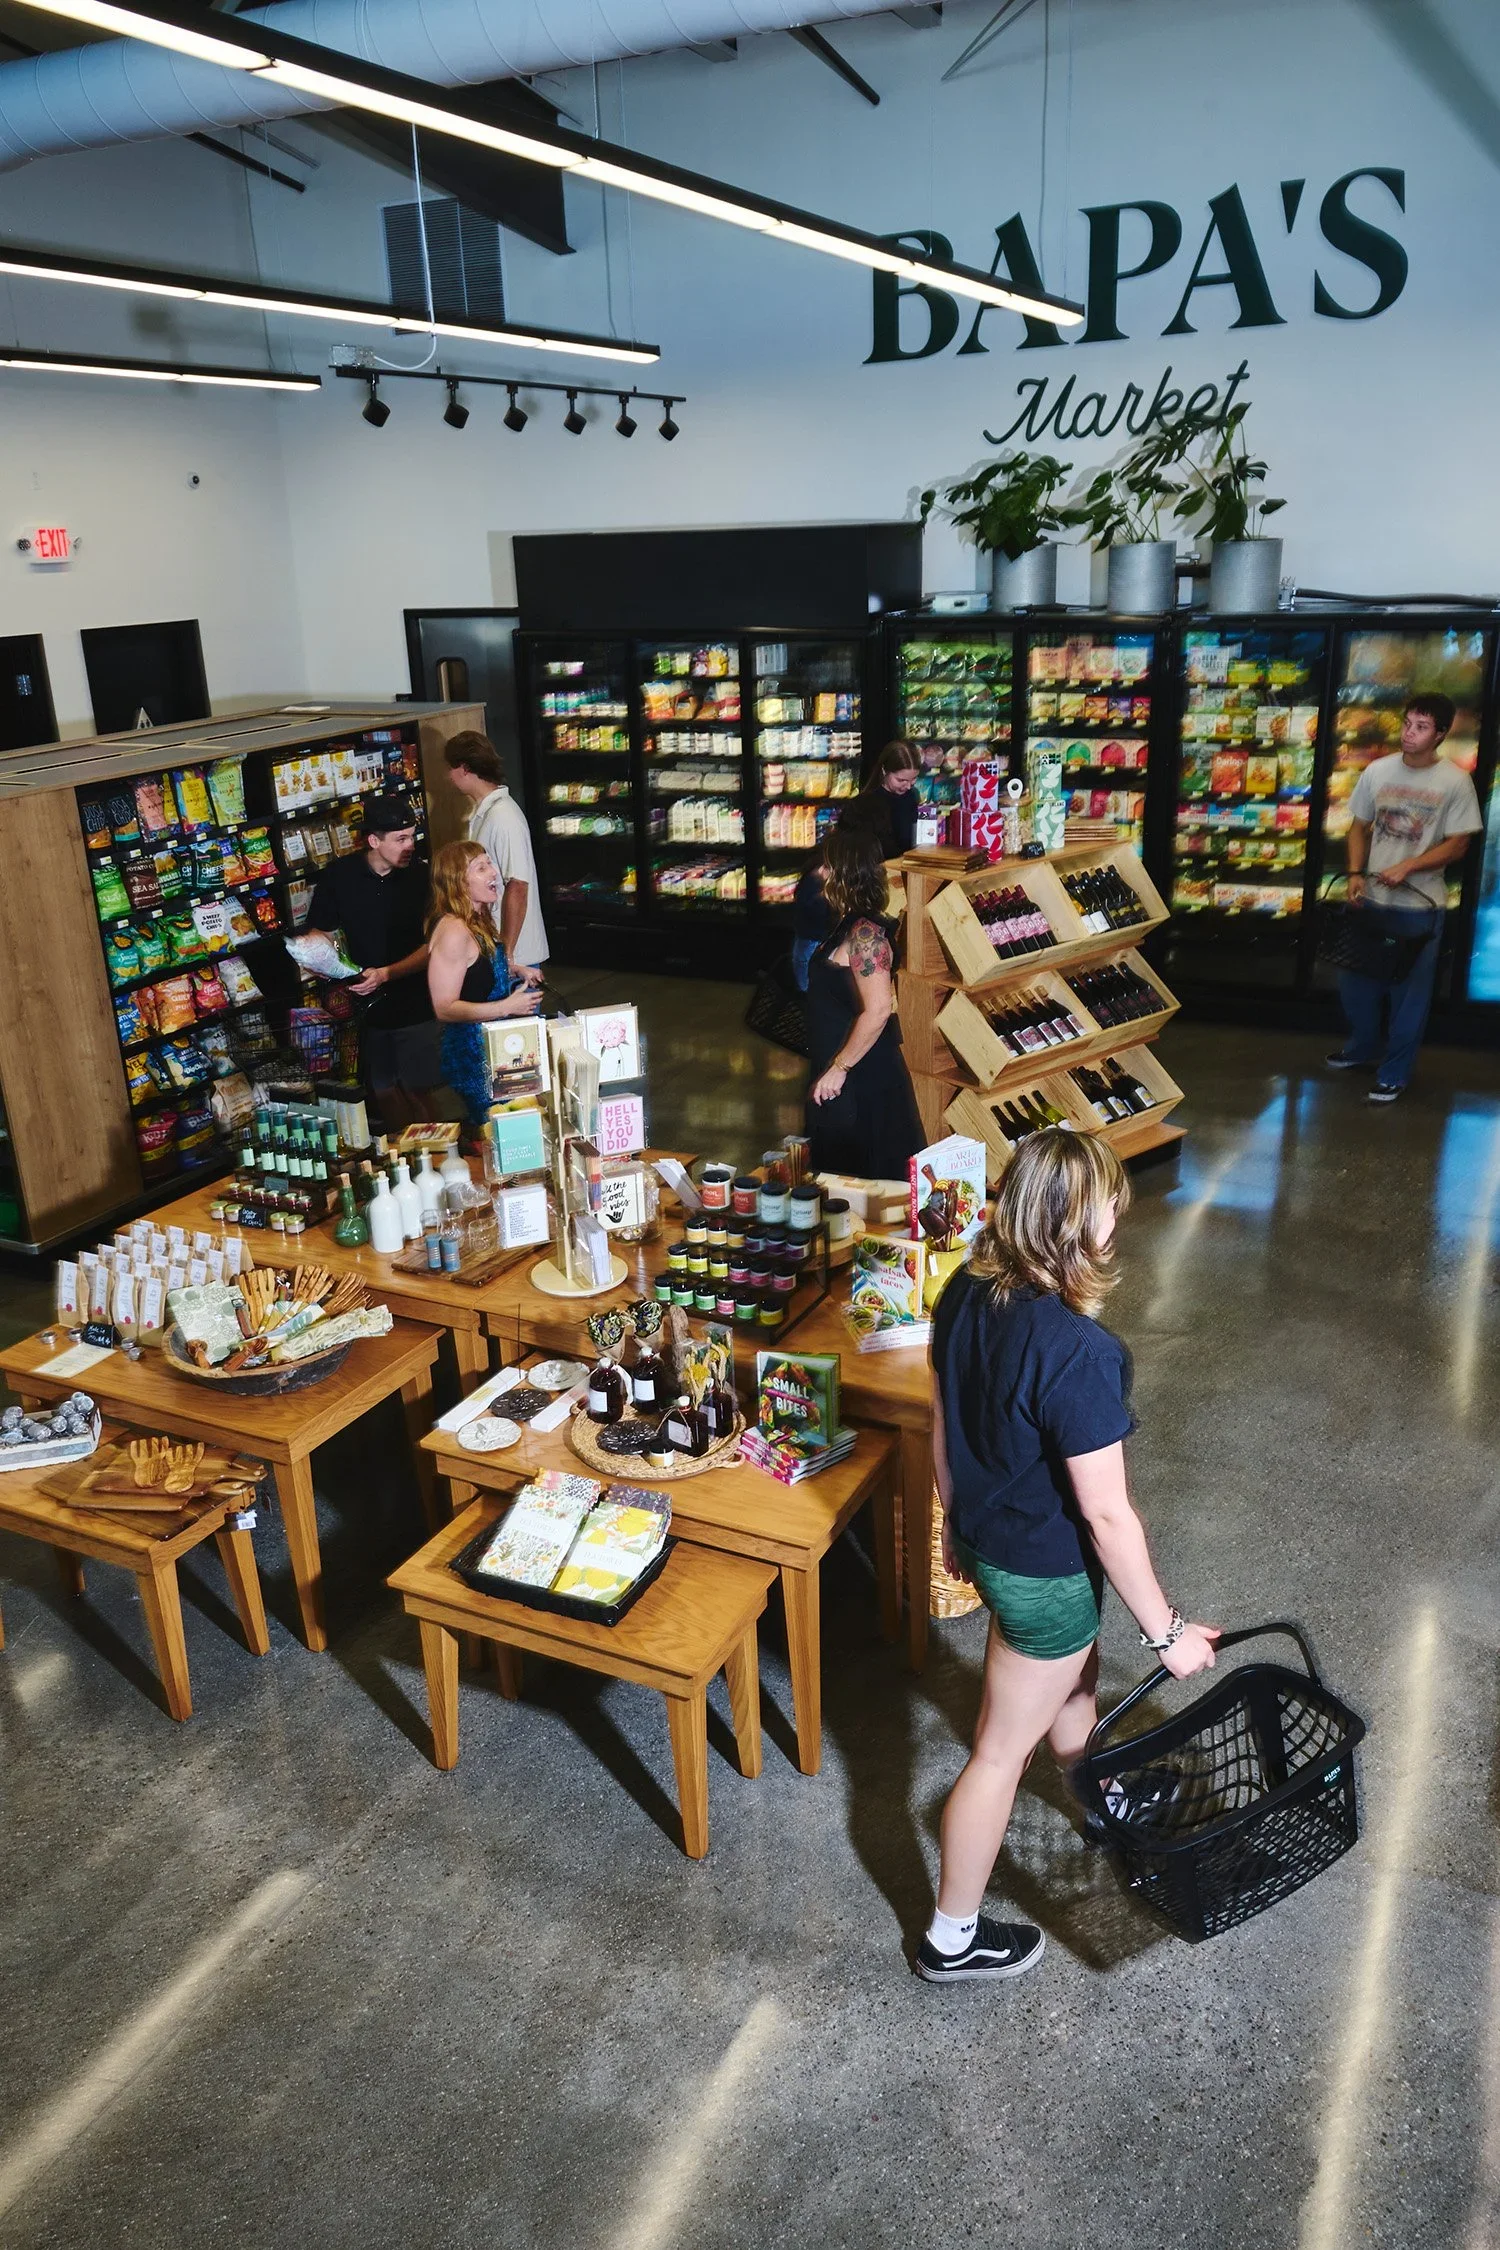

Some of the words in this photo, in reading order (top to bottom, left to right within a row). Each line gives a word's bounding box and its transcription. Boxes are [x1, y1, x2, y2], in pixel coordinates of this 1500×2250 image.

[863, 167, 1409, 364] BAPA'S
[983, 359, 1249, 444] Market
[39, 529, 68, 557] EXIT
[132, 884, 148, 894] SEA
[605, 1102, 637, 1117] HELL
[607, 1115, 631, 1128] YES
[607, 1125, 633, 1139] YOU
[607, 1138, 628, 1151] DID
[951, 1158, 982, 1170] BOARD
[613, 1181, 627, 1191] the
[879, 1265, 907, 1279] salsas
[881, 1277, 904, 1290] tacos
[772, 1377, 810, 1400] SMALL
[776, 1396, 808, 1418] BITES
